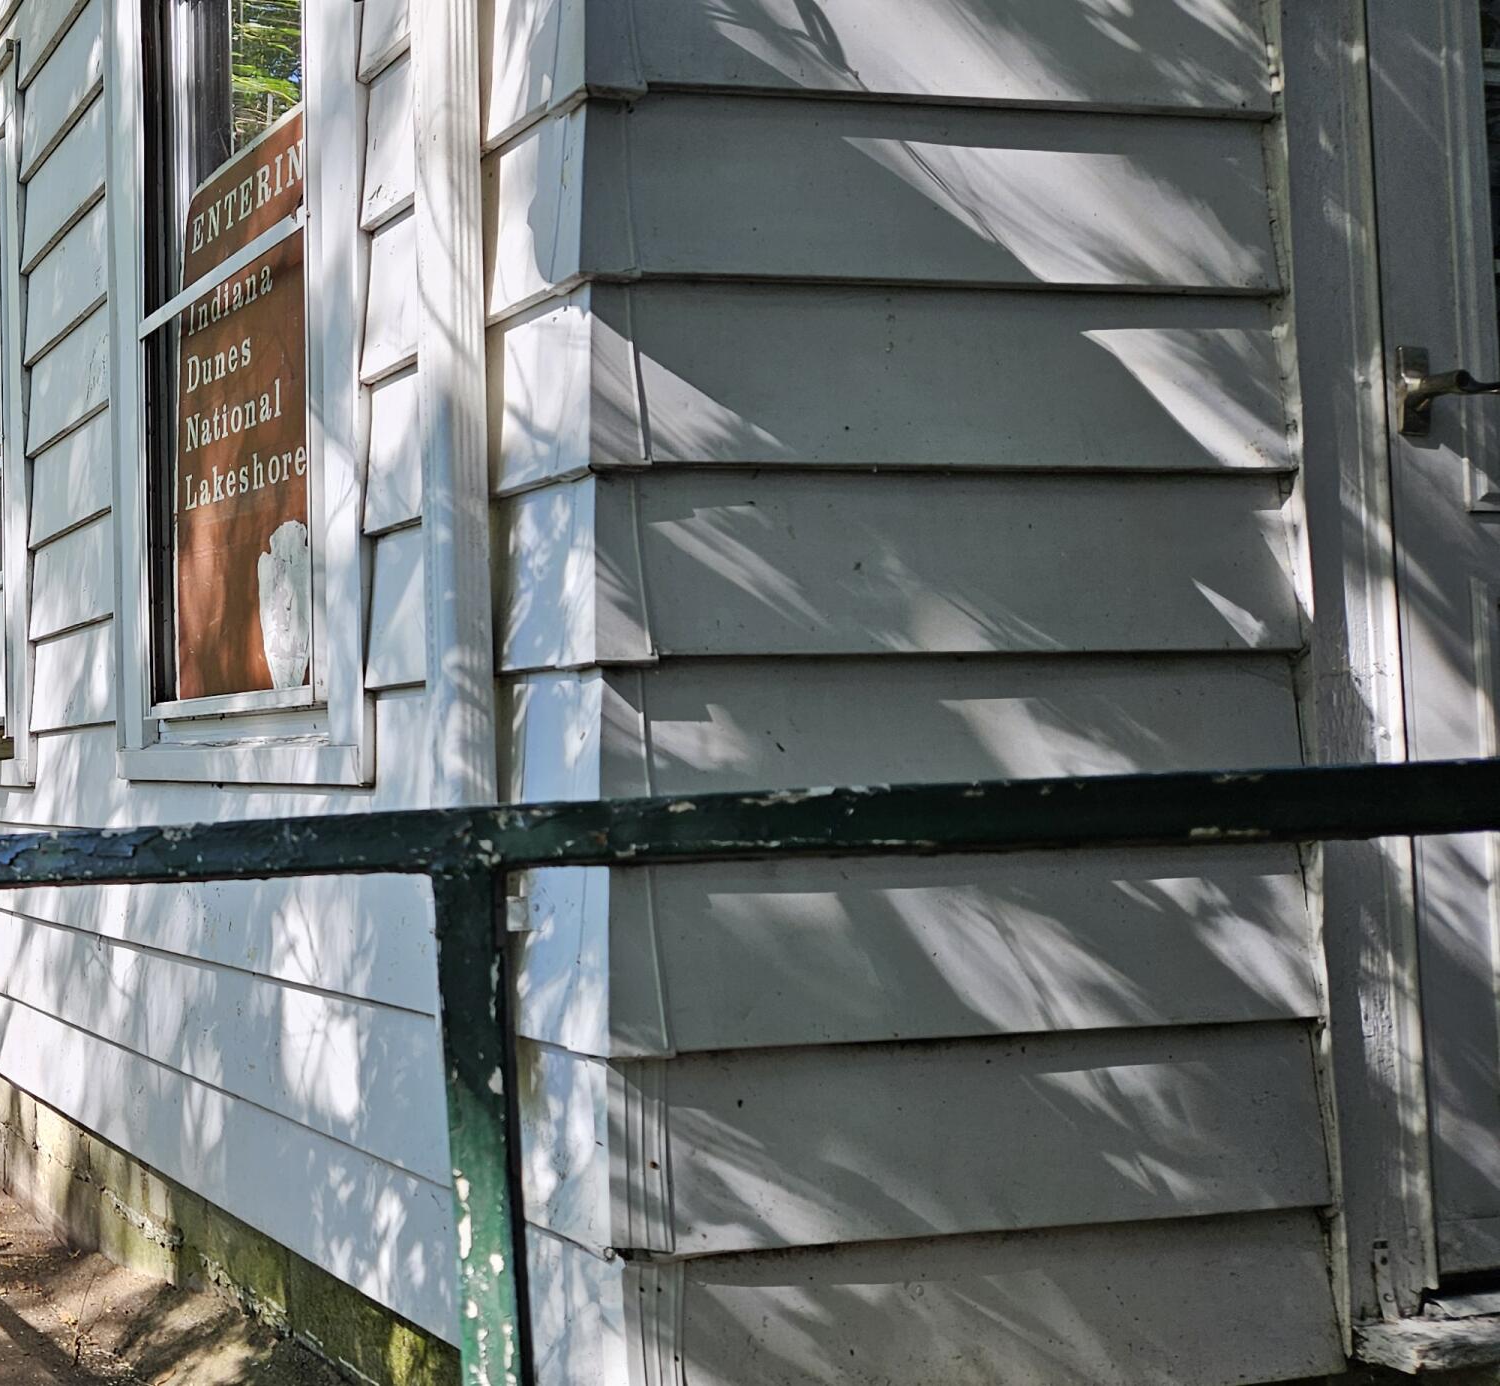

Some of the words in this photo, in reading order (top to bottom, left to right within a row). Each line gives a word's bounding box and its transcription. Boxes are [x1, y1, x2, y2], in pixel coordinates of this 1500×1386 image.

[191, 139, 303, 254] ENTERIN
[188, 265, 273, 336] Indiana
[186, 337, 251, 393] Dunes
[185, 379, 281, 453] National
[185, 446, 306, 511] Lakeshore
